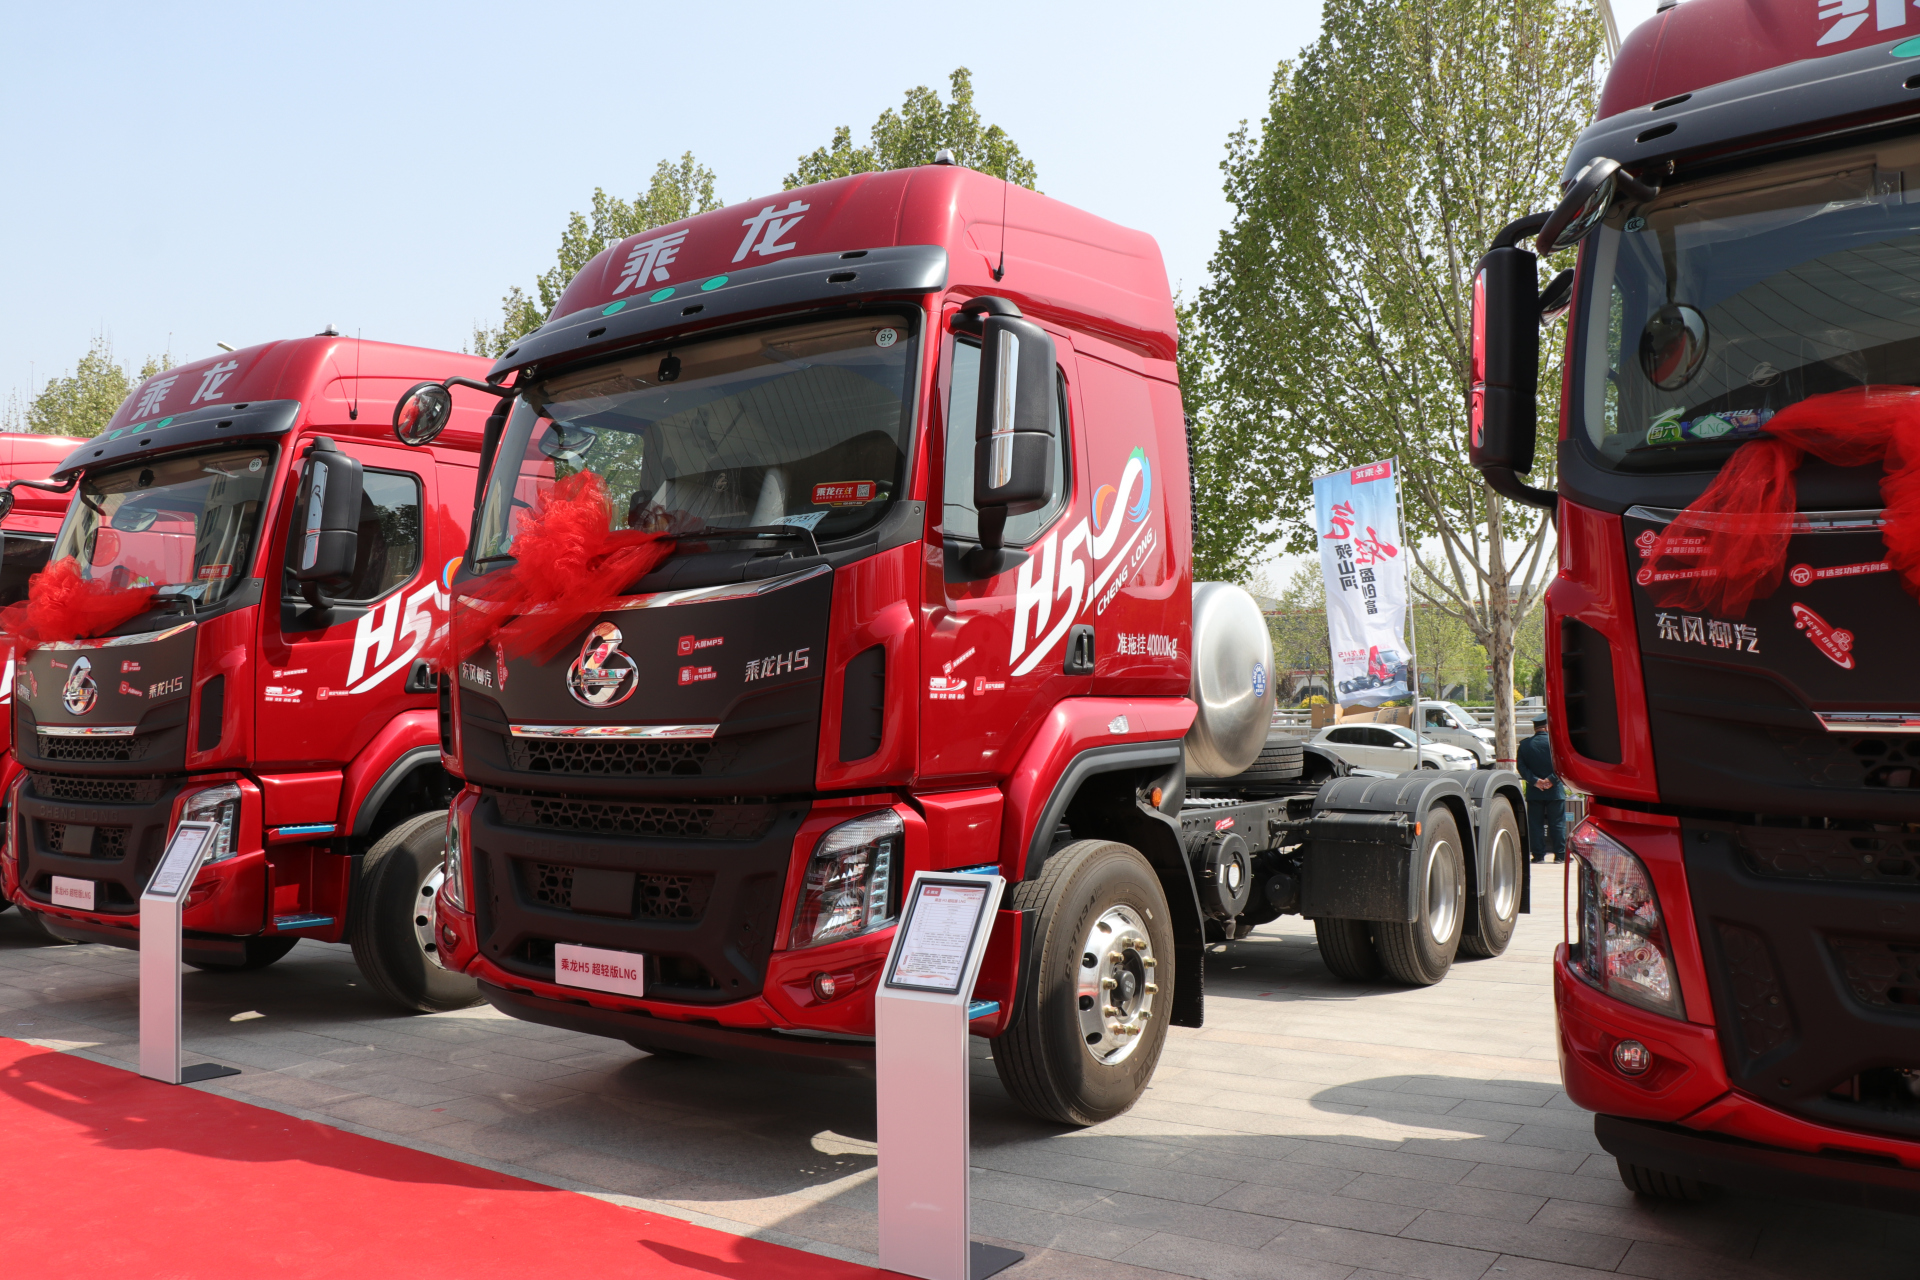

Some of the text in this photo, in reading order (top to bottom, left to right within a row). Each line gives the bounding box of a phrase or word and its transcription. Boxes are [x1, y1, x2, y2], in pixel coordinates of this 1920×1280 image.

[612, 200, 810, 296] 乘龙
[880, 333, 893, 342] 89
[130, 360, 239, 421] 乘龙
[1699, 422, 1725, 435] LNG
[1097, 527, 1152, 616] CHENG LONG
[1010, 517, 1089, 676] H5
[1655, 612, 1760, 654] 东风柳汽
[744, 647, 810, 682] 乘龙H5
[561, 958, 637, 980] 乘龙H5 超轻版LNG
